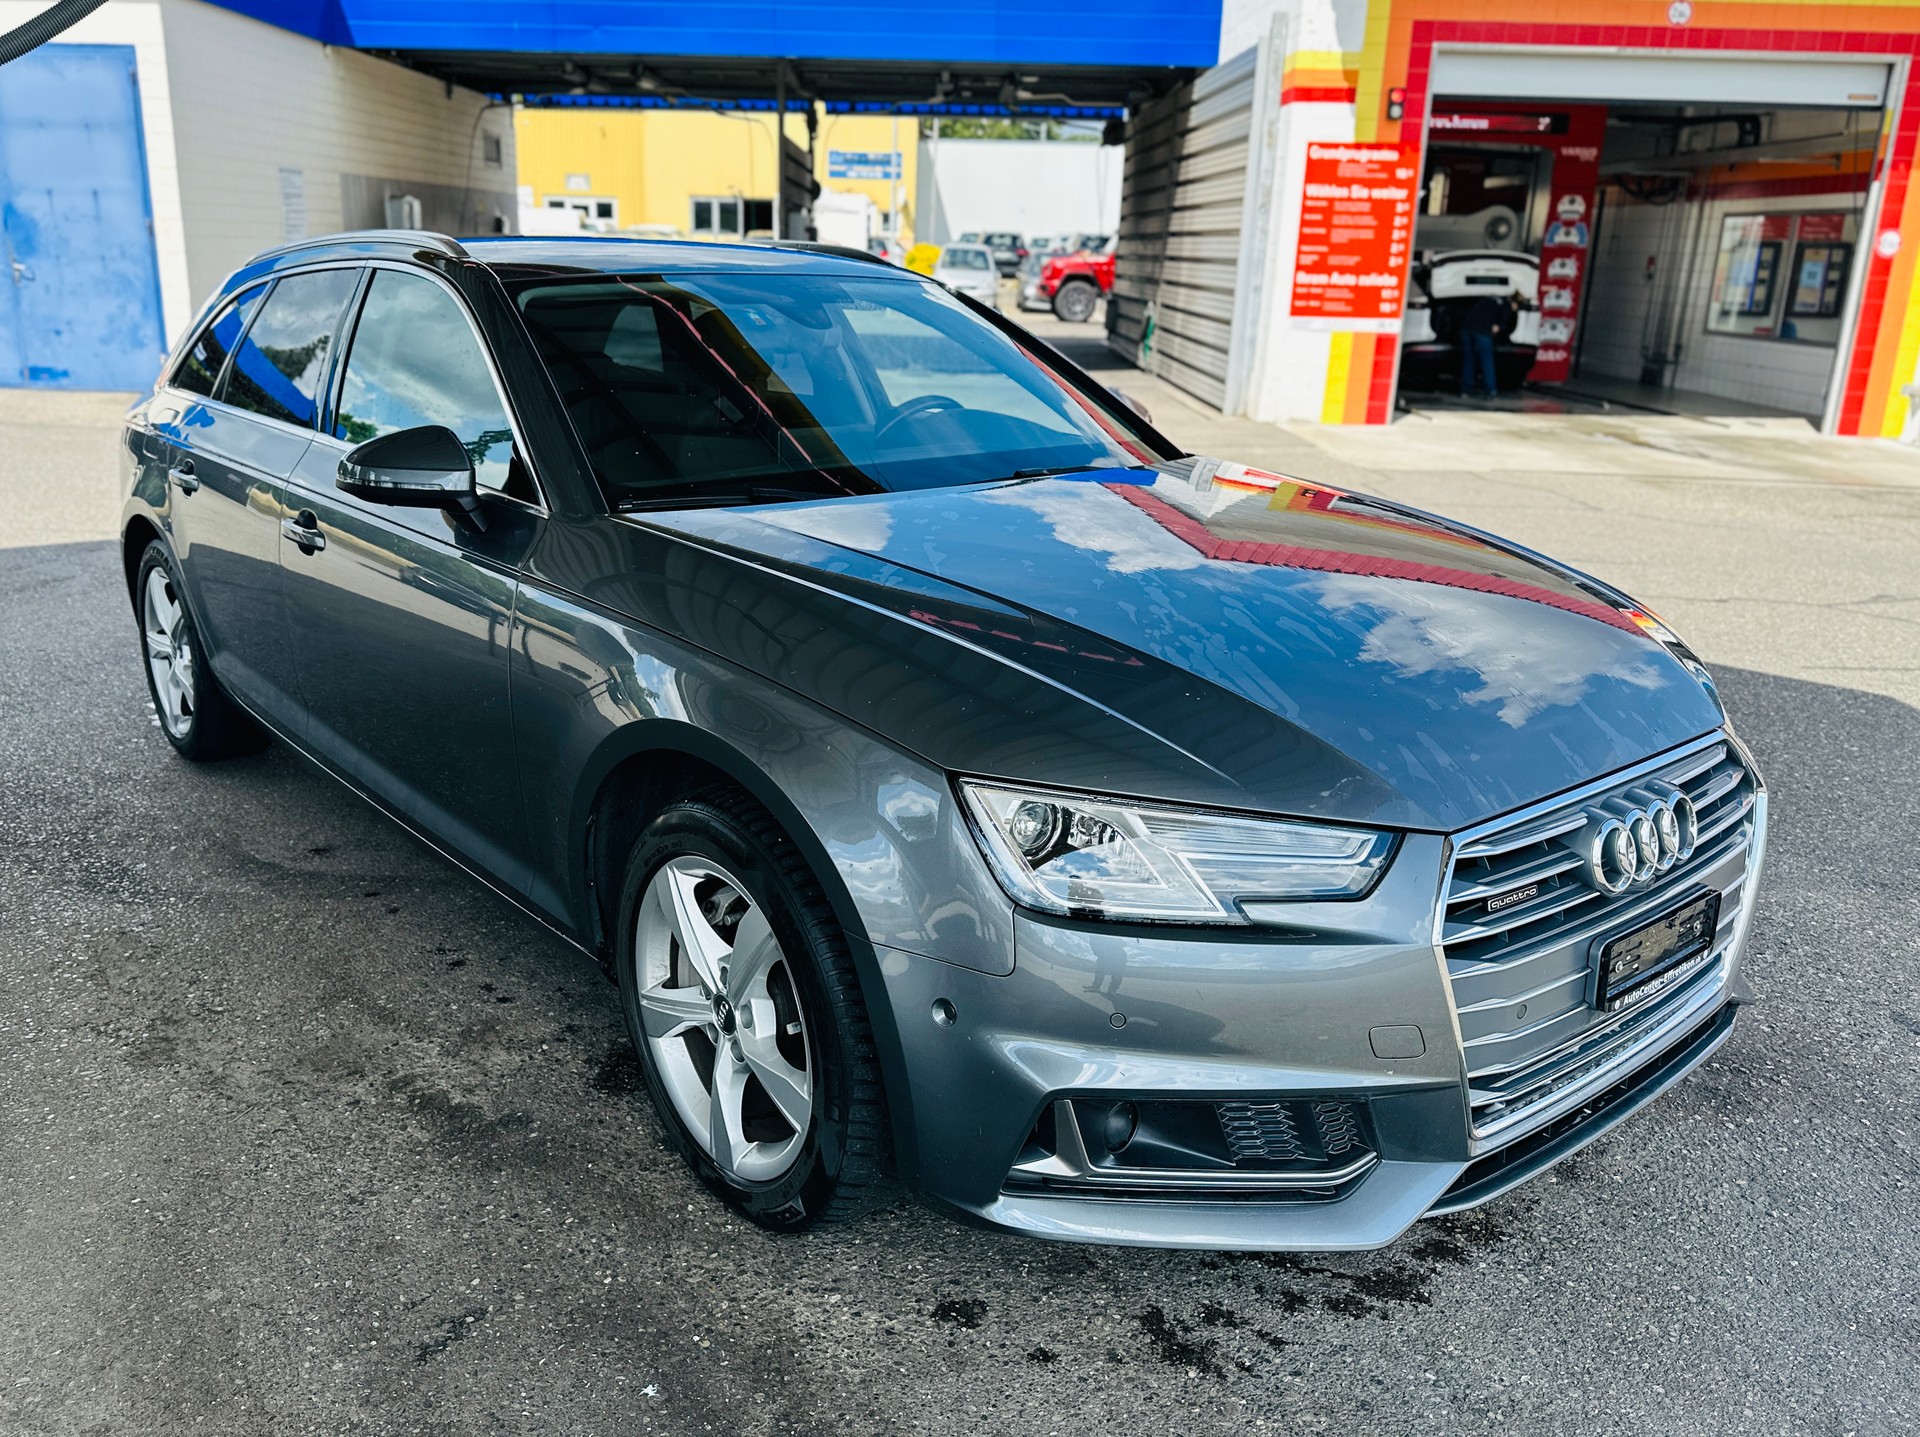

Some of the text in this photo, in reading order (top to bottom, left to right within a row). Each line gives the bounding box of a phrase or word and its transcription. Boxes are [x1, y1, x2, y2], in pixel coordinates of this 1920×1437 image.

[1305, 183, 1408, 200] Wählen Sie weiter
[1330, 271, 1357, 286] Auto
[1358, 272, 1398, 287] zuliebe
[1491, 888, 1537, 908] quattro
